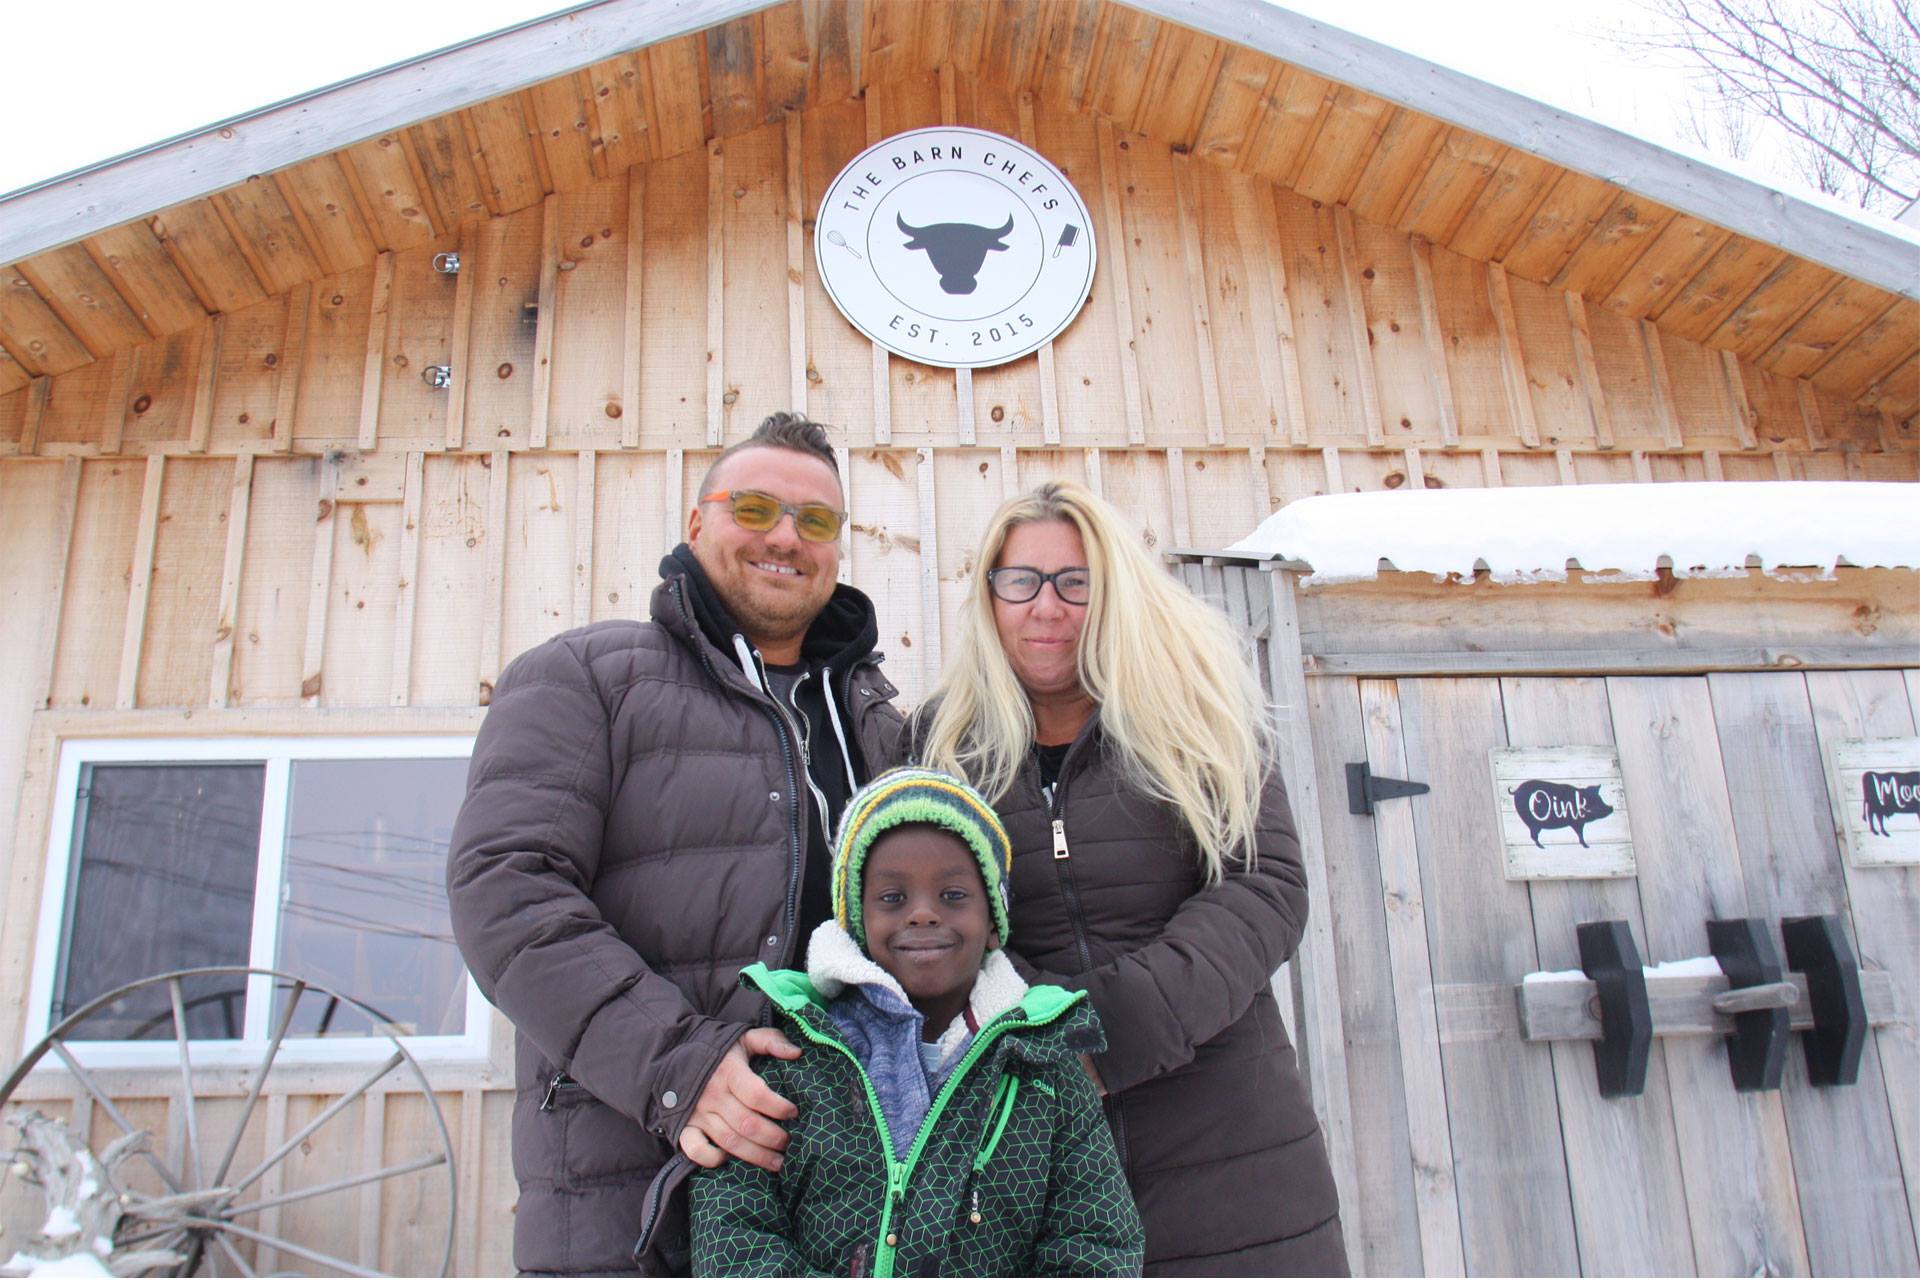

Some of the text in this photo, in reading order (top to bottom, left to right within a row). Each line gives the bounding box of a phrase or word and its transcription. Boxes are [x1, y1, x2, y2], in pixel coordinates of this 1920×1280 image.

[844, 146, 1059, 211] THE BARN CHEFS
[889, 314, 1034, 346] EST. 2015
[1528, 789, 1592, 821] Oink
